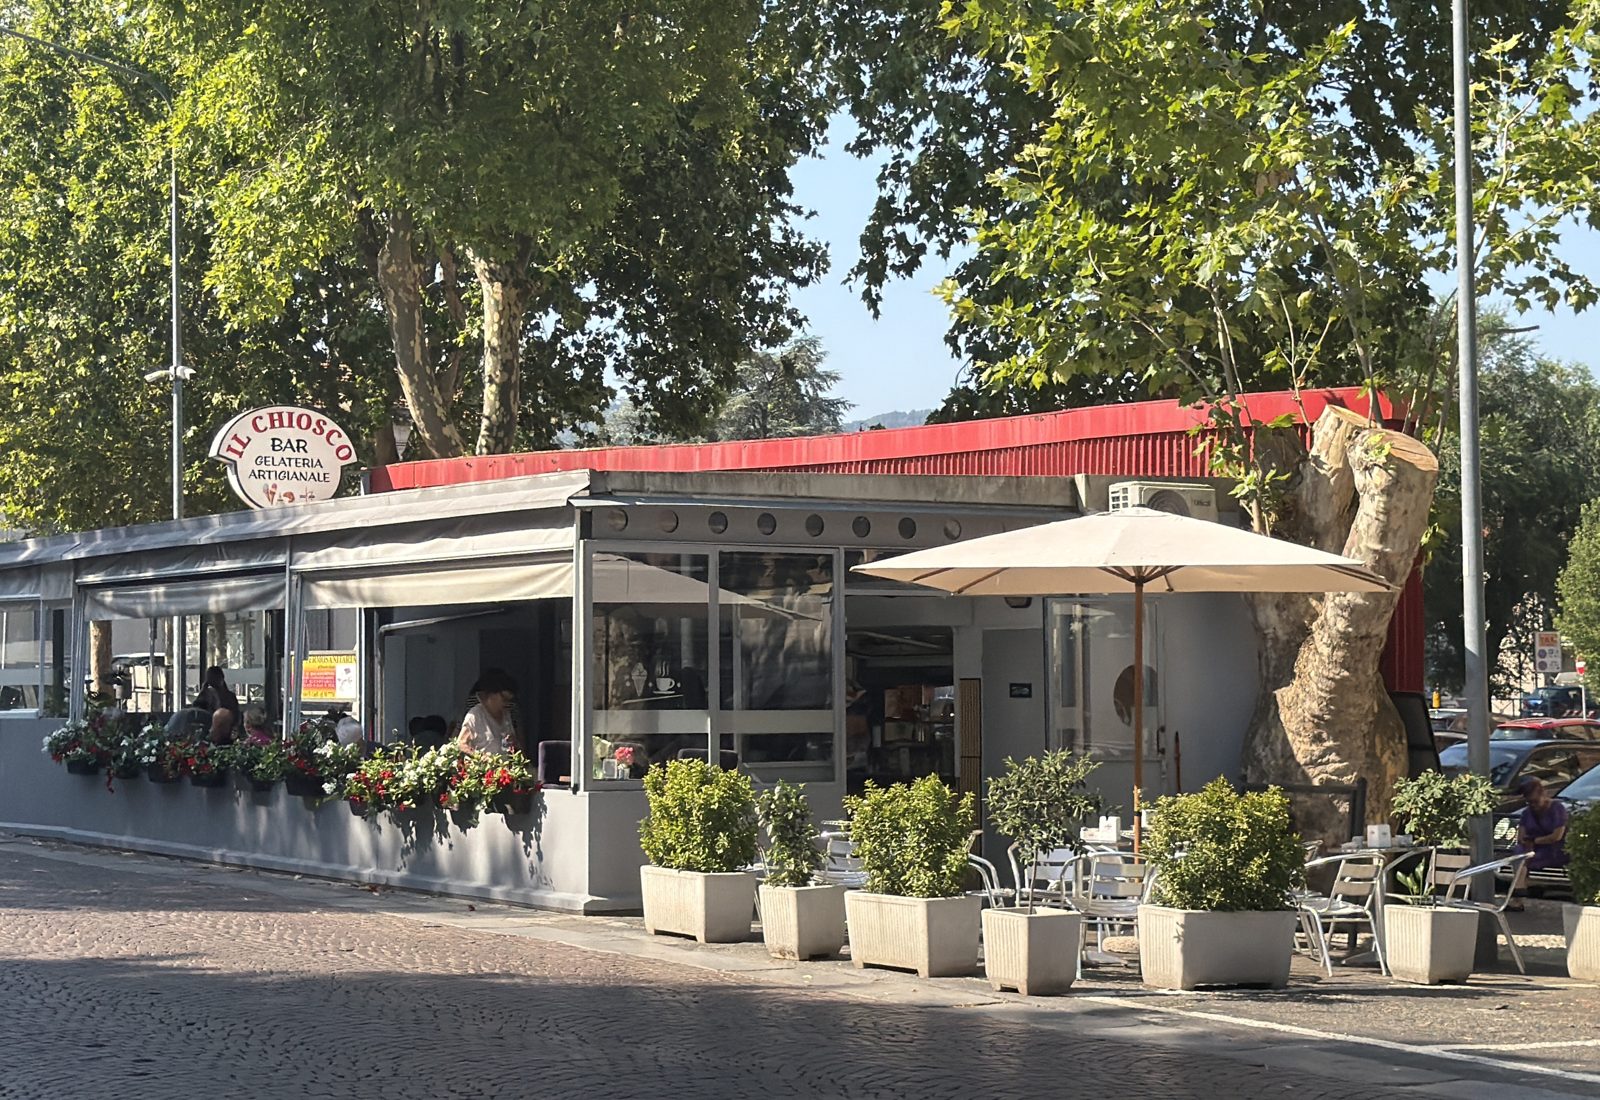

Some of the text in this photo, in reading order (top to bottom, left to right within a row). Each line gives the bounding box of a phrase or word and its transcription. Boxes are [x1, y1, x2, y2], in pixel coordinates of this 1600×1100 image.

[226, 411, 353, 461] IL CHIOSCO
[270, 437, 308, 454] BAR
[254, 455, 323, 469] GELATERIA
[248, 469, 331, 483] ARTIGIANALE
